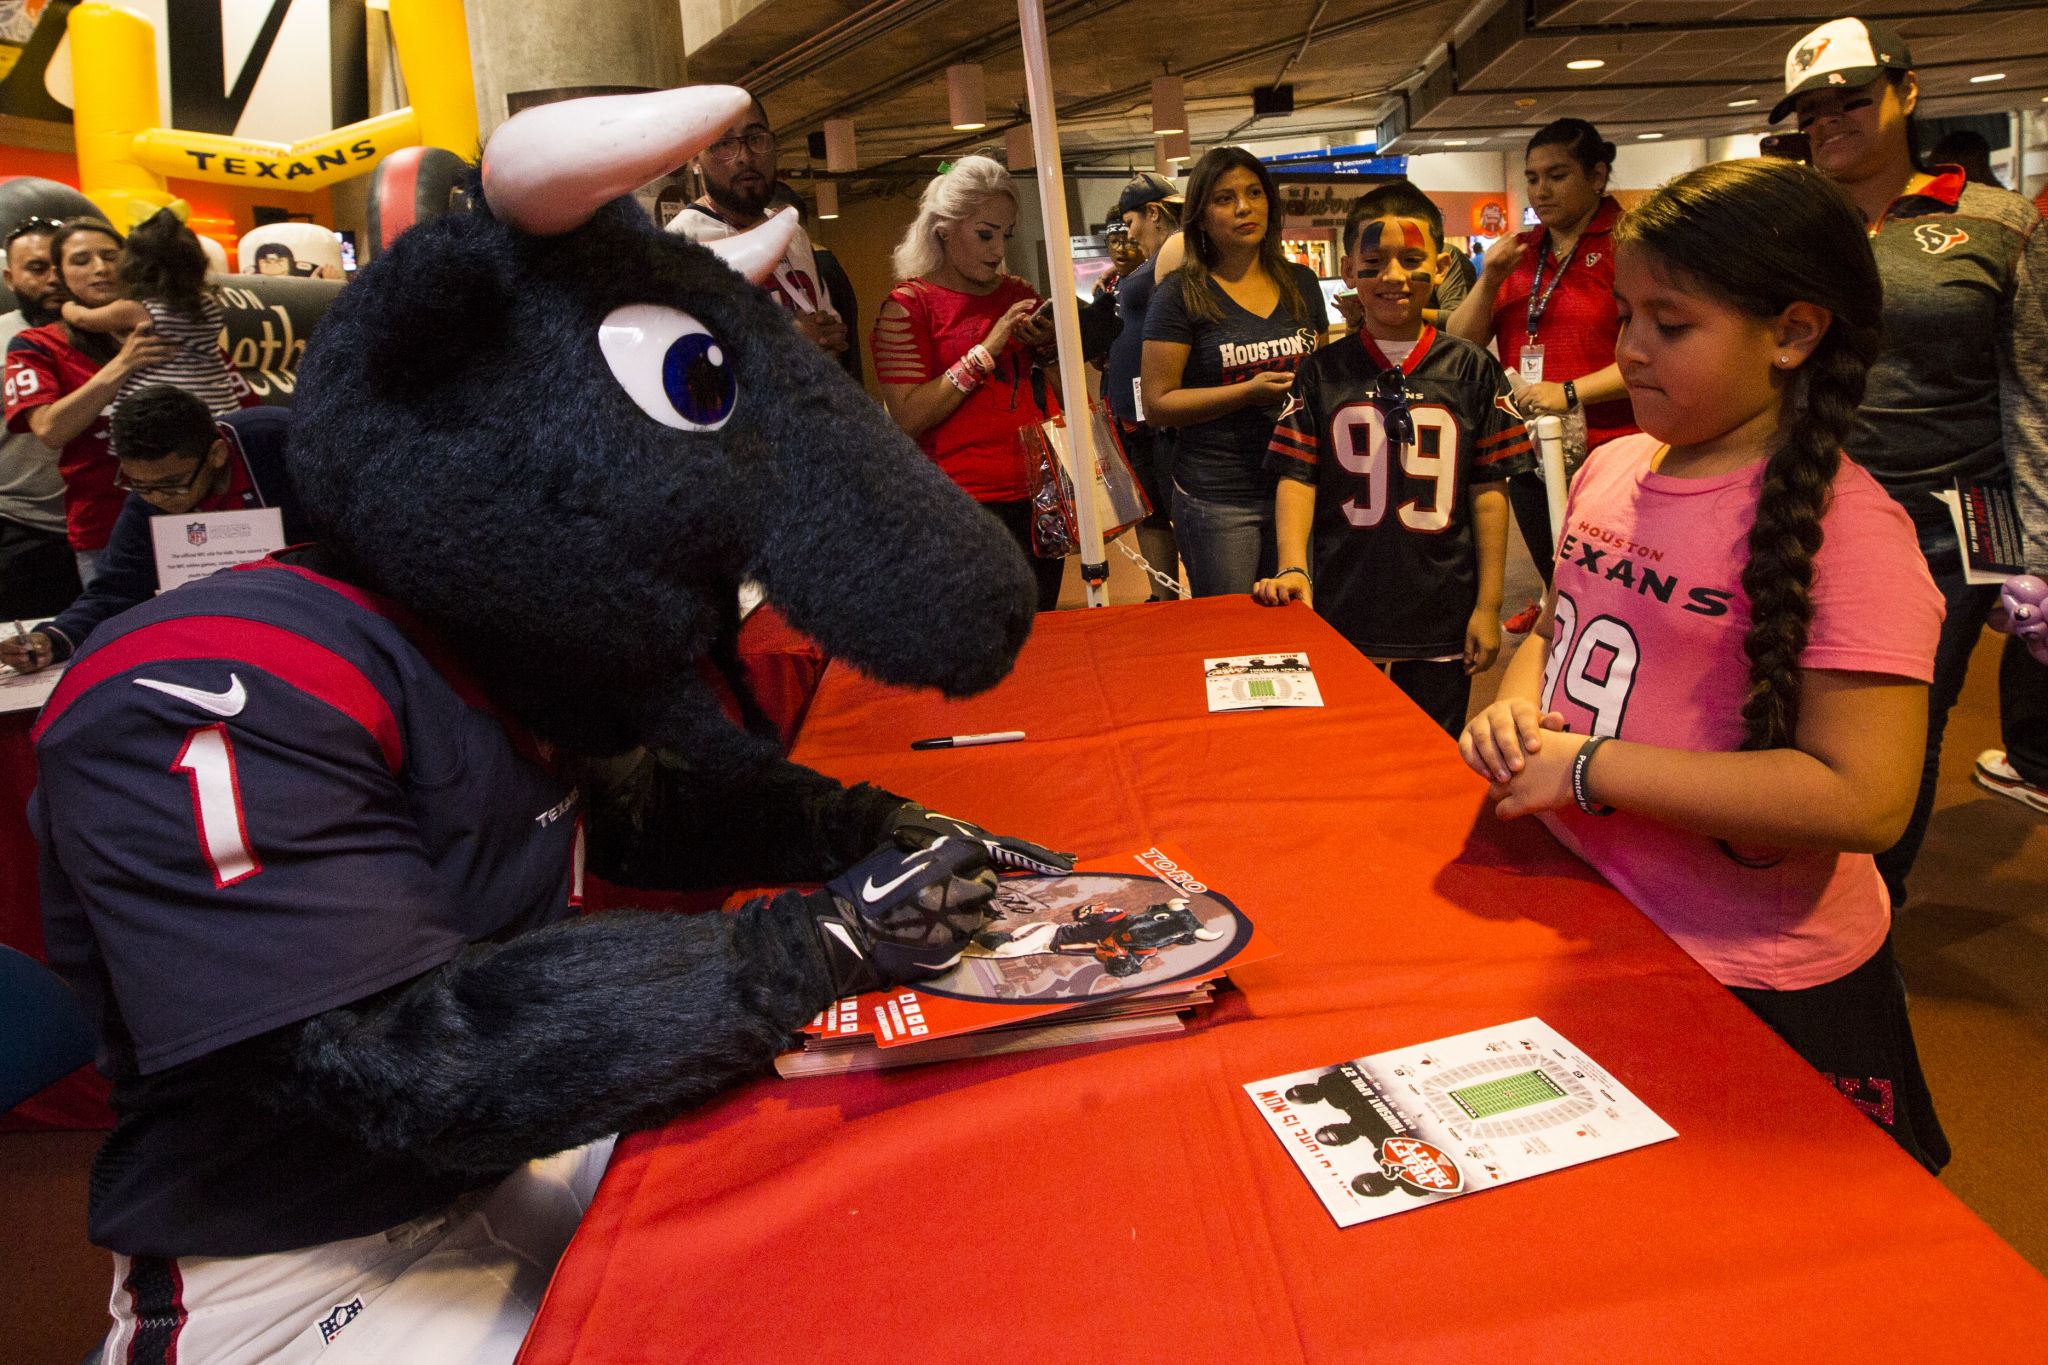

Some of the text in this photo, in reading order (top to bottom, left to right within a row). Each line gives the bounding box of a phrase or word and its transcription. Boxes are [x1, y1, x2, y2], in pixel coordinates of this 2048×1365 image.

[185, 138, 376, 180] TEXANS
[1219, 335, 1304, 368] HOUSTON
[4, 368, 40, 407] 99
[1330, 401, 1460, 535] 99
[1578, 520, 1665, 562] HOUSTON
[1559, 534, 1735, 617] EXANS
[1575, 754, 1587, 801] Presented
[169, 721, 265, 890] 1
[1140, 847, 1208, 894] TORO
[1340, 1067, 1358, 1078] 27
[1350, 1076, 1375, 1097] APRIL
[1256, 1090, 1290, 1113] NOW
[1386, 1140, 1434, 1186] DRAFT
[1403, 1141, 1453, 1188] PARTY
